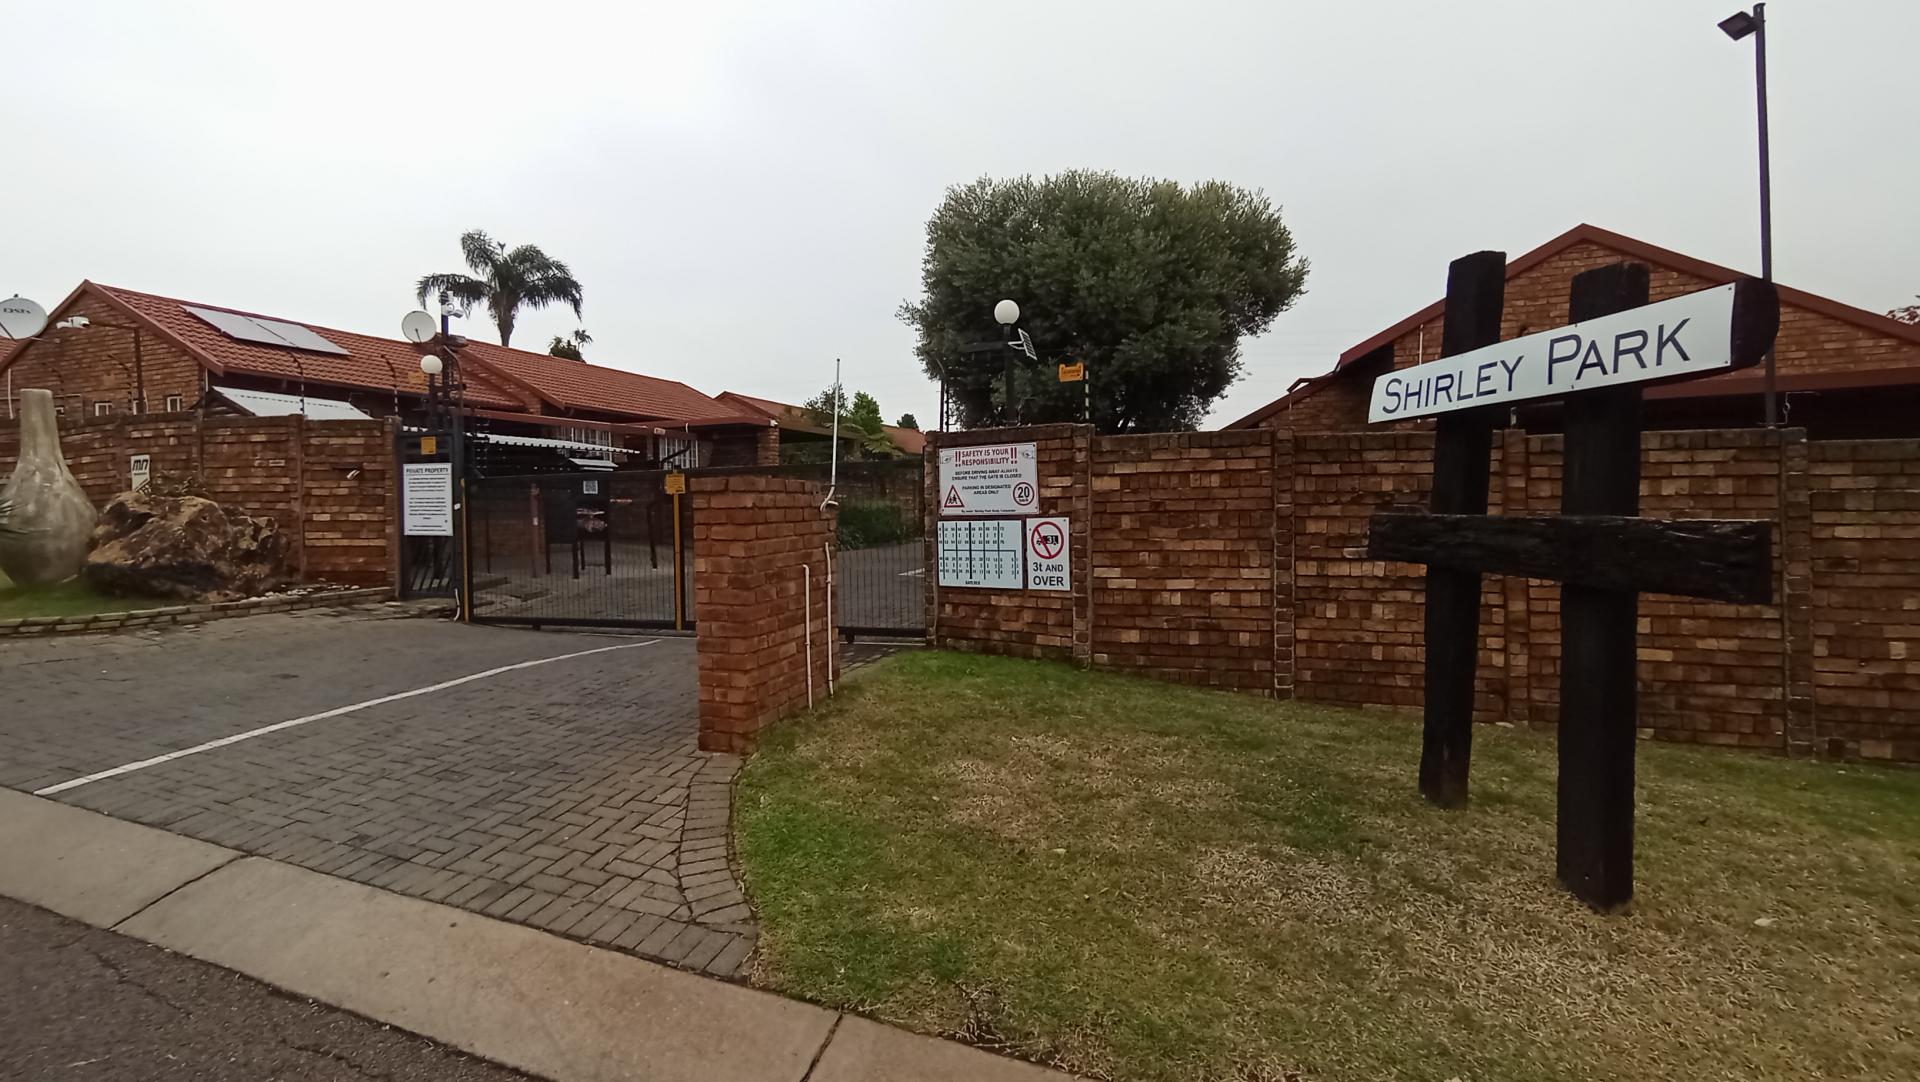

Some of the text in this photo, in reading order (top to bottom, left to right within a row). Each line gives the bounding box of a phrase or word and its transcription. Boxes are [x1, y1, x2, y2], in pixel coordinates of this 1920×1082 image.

[1382, 317, 1691, 415] SHIRLEY PARK
[961, 449, 984, 458] SAFETY
[984, 449, 990, 457] IS
[991, 447, 1009, 456] YOUR
[961, 457, 1010, 466] RESPONSIBILITY
[1017, 486, 1030, 498] 20
[1032, 561, 1043, 572] 3t
[1045, 563, 1064, 573] AND
[1033, 575, 1065, 587] OVER
